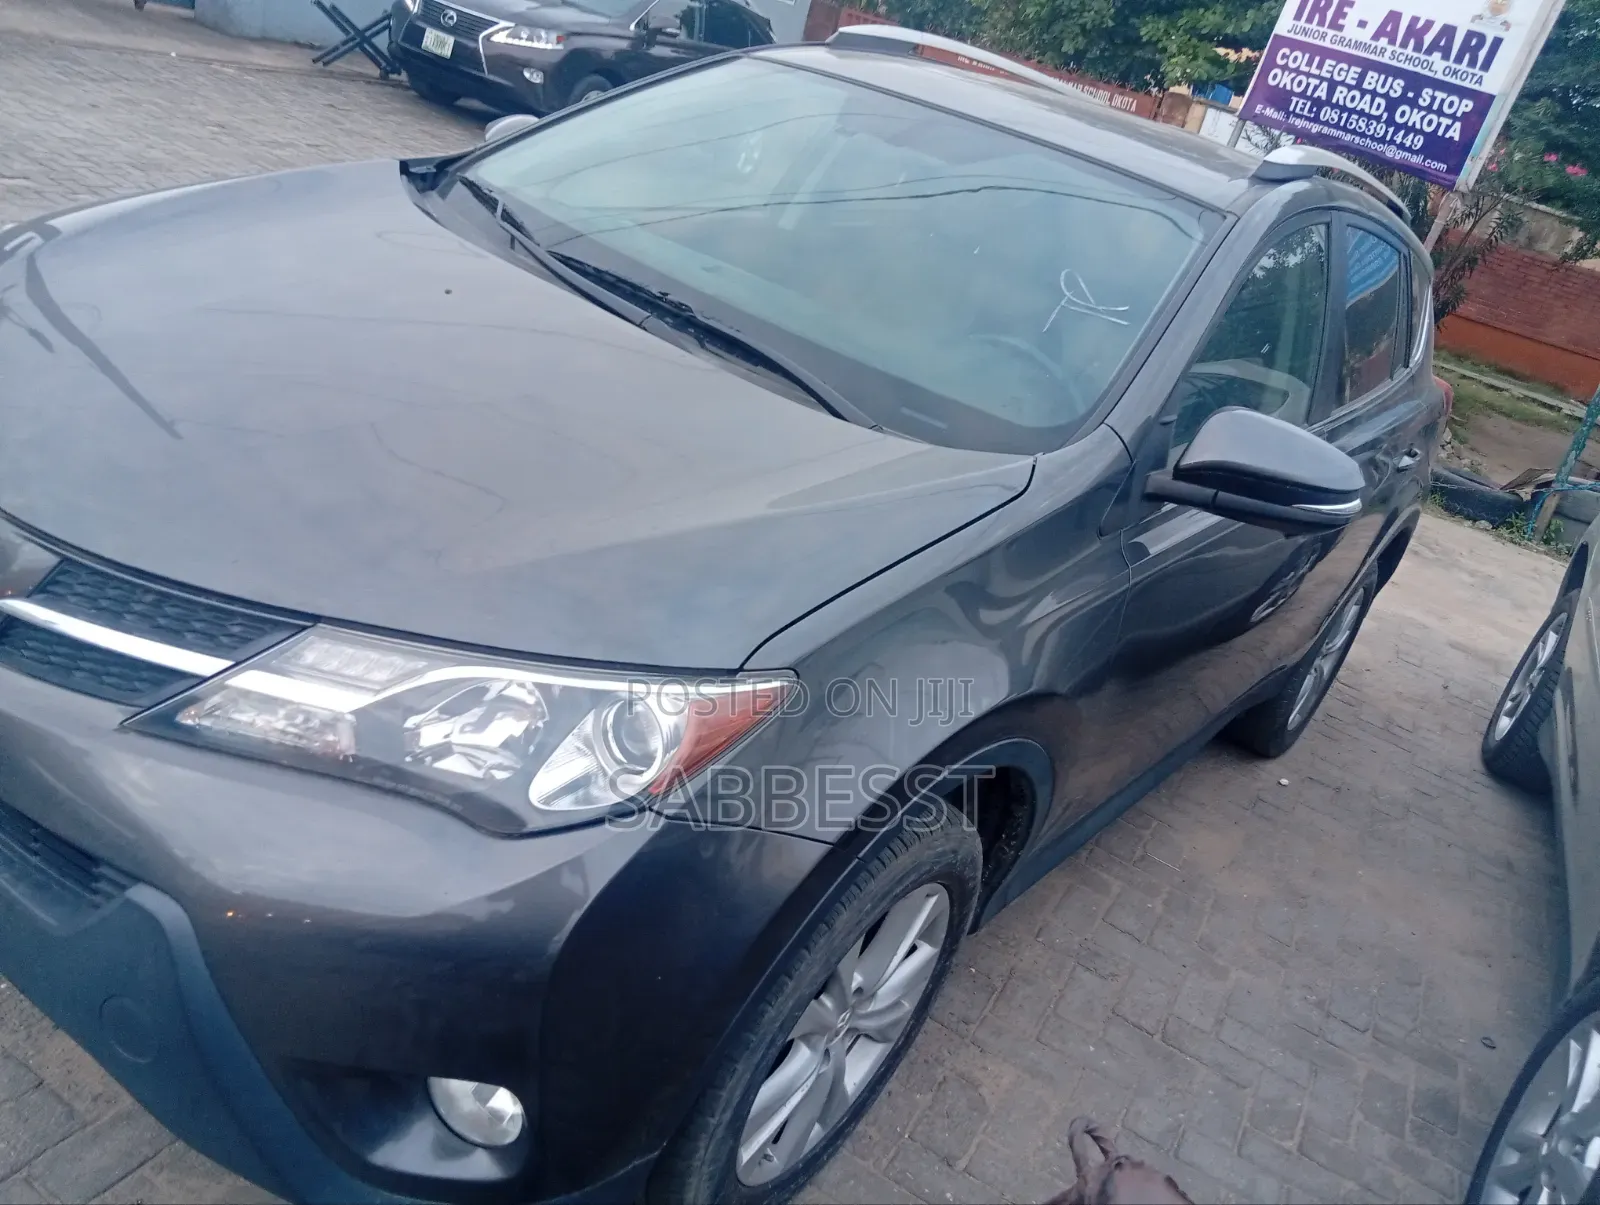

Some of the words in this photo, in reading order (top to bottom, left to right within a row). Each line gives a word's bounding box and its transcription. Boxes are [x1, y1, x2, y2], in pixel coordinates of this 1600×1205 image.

[1287, 23, 1328, 43] JUNIOR
[1329, 34, 1387, 59] GRAMMAR
[1388, 48, 1438, 77] SCHOOL,
[1442, 65, 1485, 88] OKOTA
[1292, 0, 1355, 33] IRE
[1369, 9, 1504, 73] AKARI
[1111, 93, 1138, 113] OKOTA
[1254, 103, 1287, 122] E-Mail:
[1267, 67, 1329, 101] OKOTA
[1331, 85, 1388, 122] ROAD,
[1394, 104, 1462, 142] OKOTA
[1275, 47, 1362, 86] COLLEGE
[1362, 70, 1405, 98] BUS
[1418, 87, 1474, 118] STOP
[1288, 96, 1317, 118] TEL:
[1319, 105, 1424, 151] 08158391449
